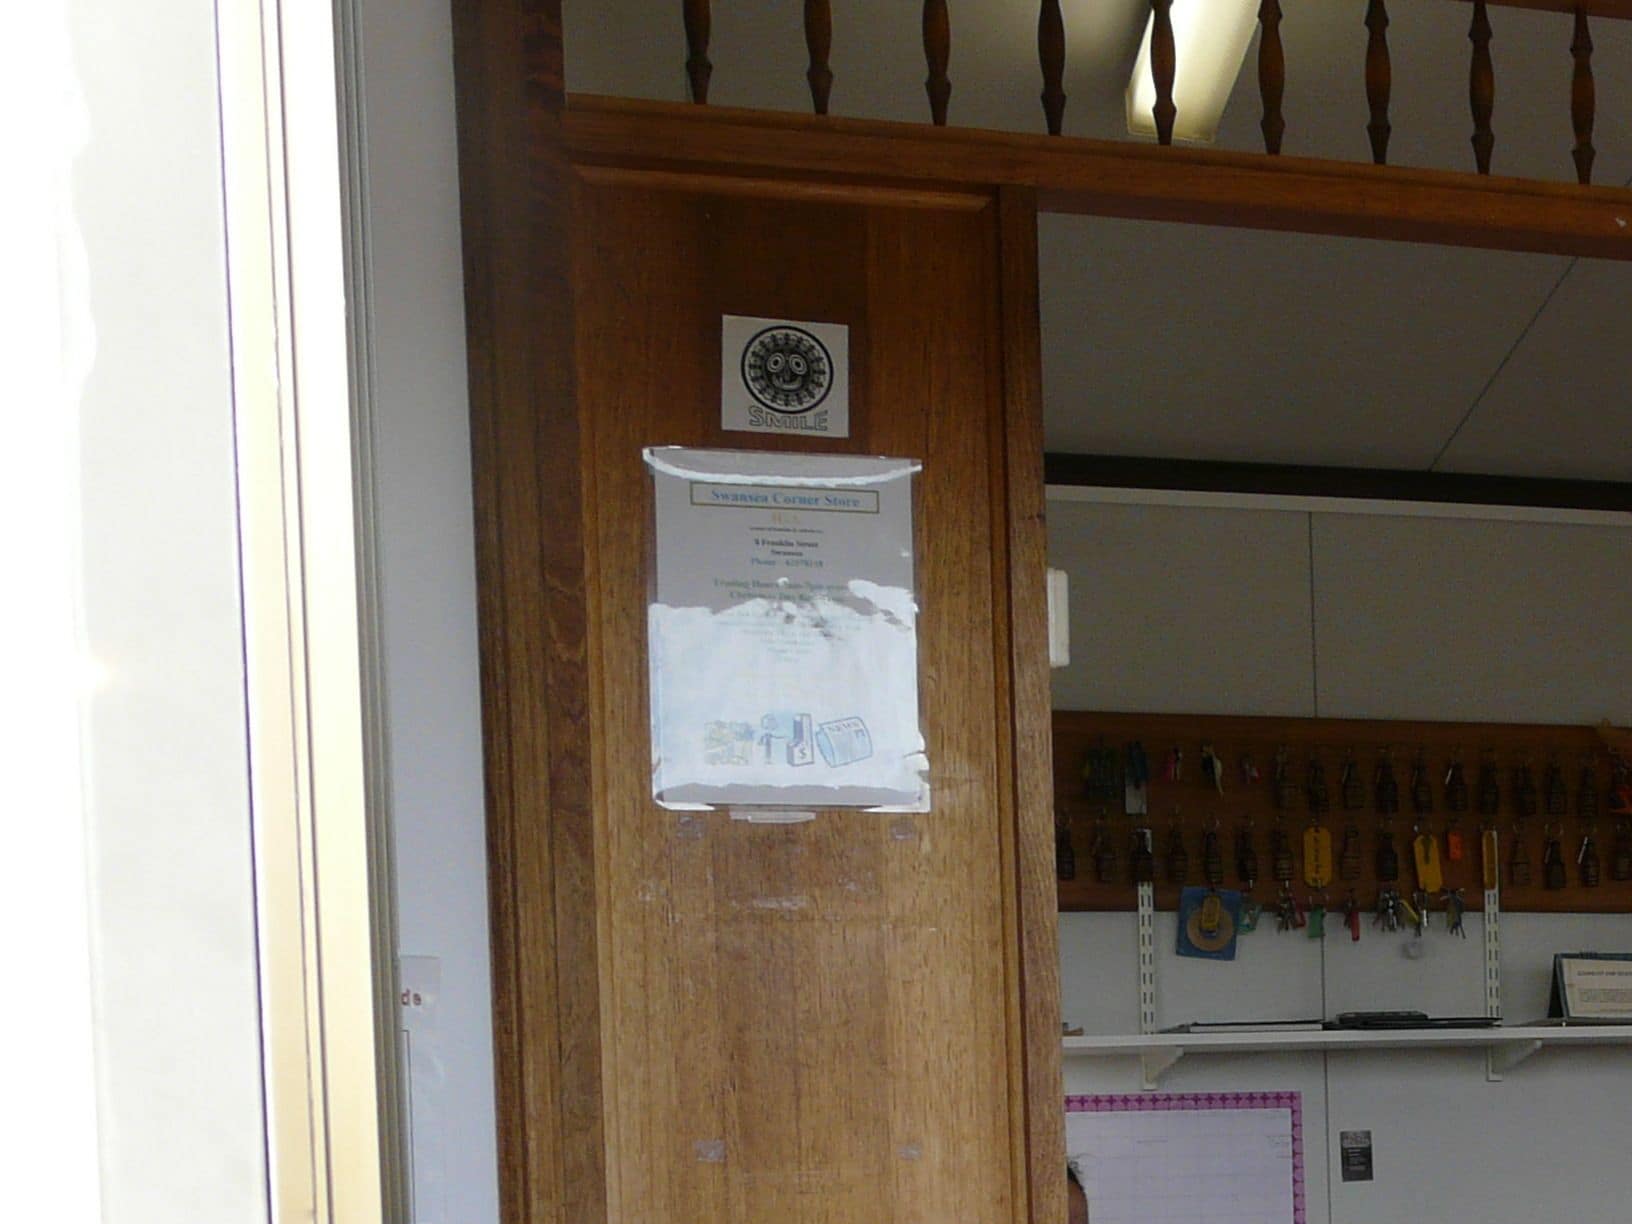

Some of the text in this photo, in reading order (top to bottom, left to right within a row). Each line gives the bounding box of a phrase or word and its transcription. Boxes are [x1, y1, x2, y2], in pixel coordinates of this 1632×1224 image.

[748, 405, 829, 431] SMILE
[712, 489, 861, 507] Swansea Corner Store
